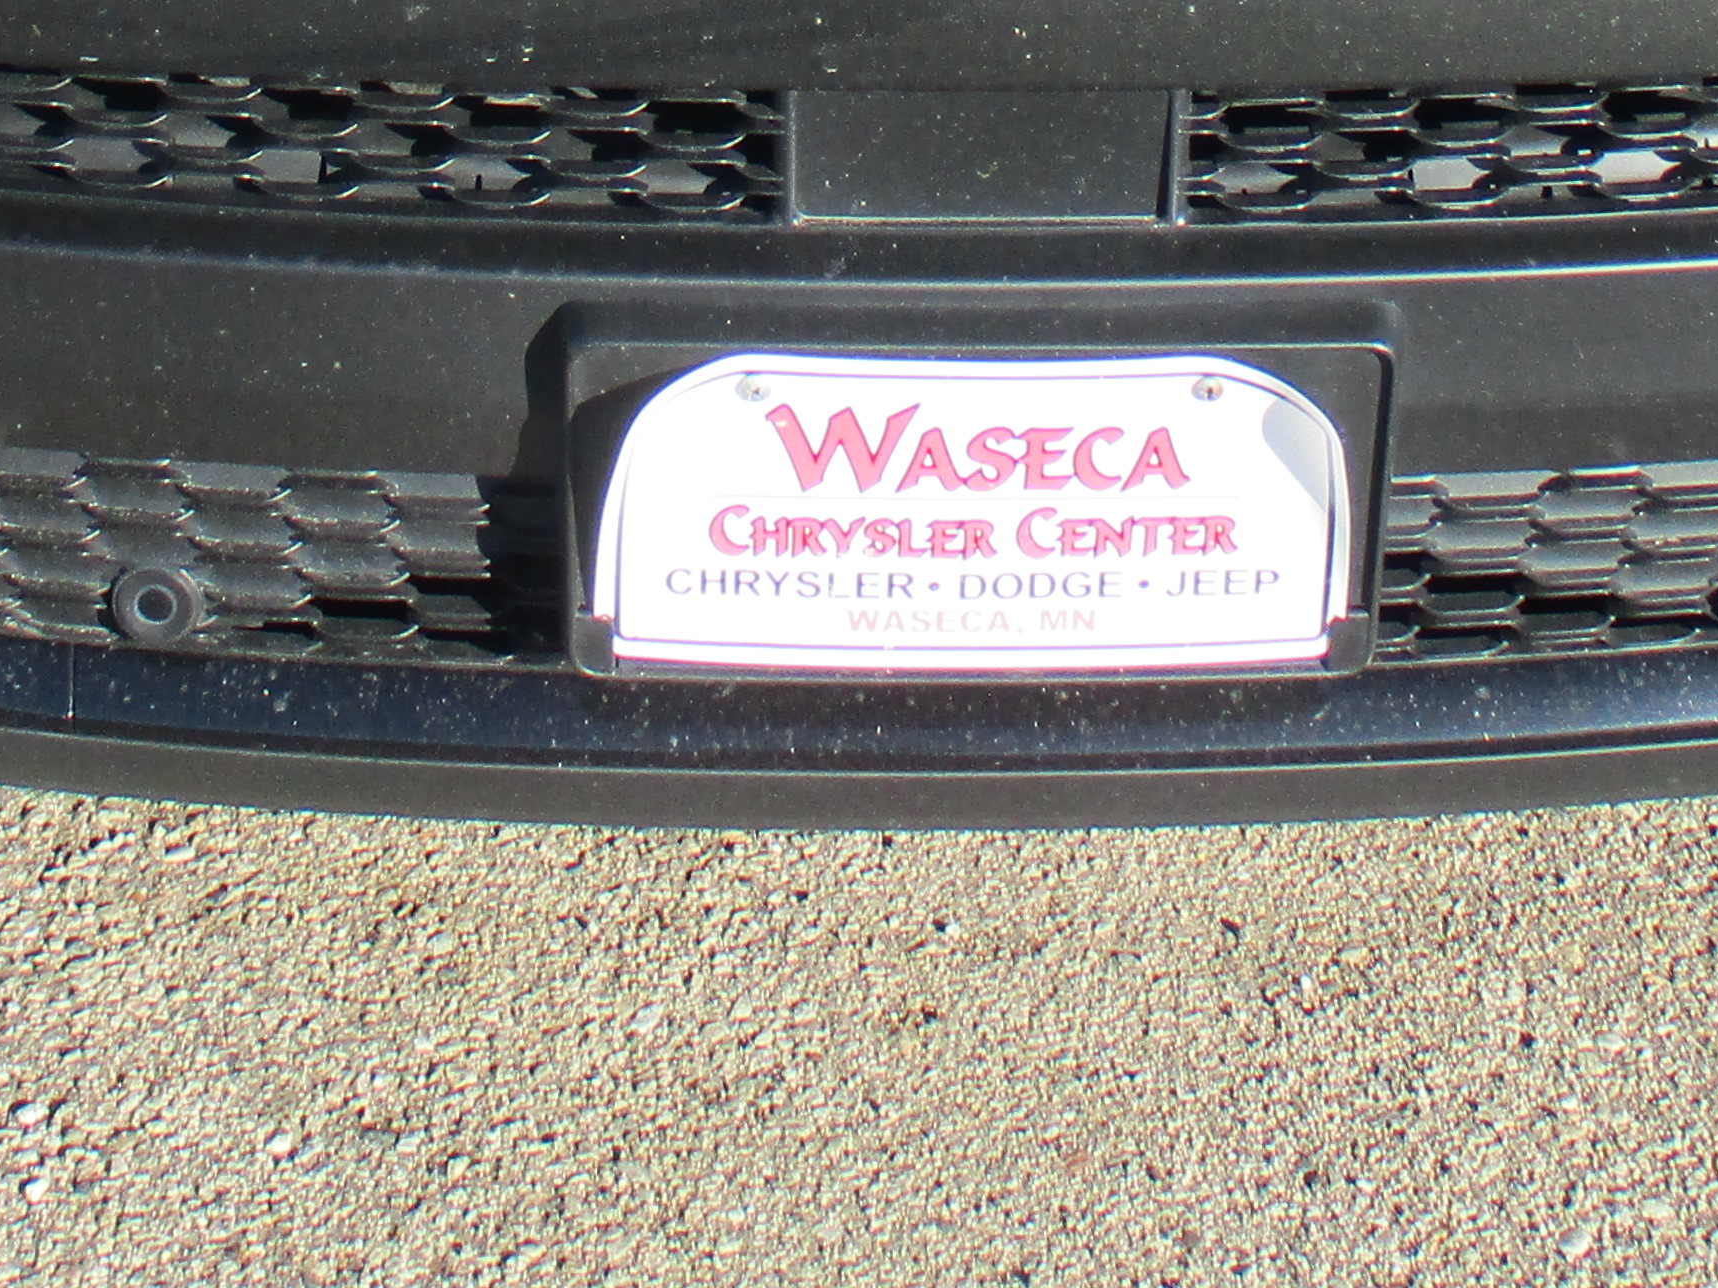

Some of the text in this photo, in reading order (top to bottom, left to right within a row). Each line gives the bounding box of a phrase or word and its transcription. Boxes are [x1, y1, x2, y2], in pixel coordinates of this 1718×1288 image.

[764, 402, 1191, 494] WASECA
[708, 505, 1239, 560] CHRYSLER CENTER
[665, 568, 1281, 600] CHRYSLER DODGE JEEP
[847, 608, 1096, 637] WASECA, MN
